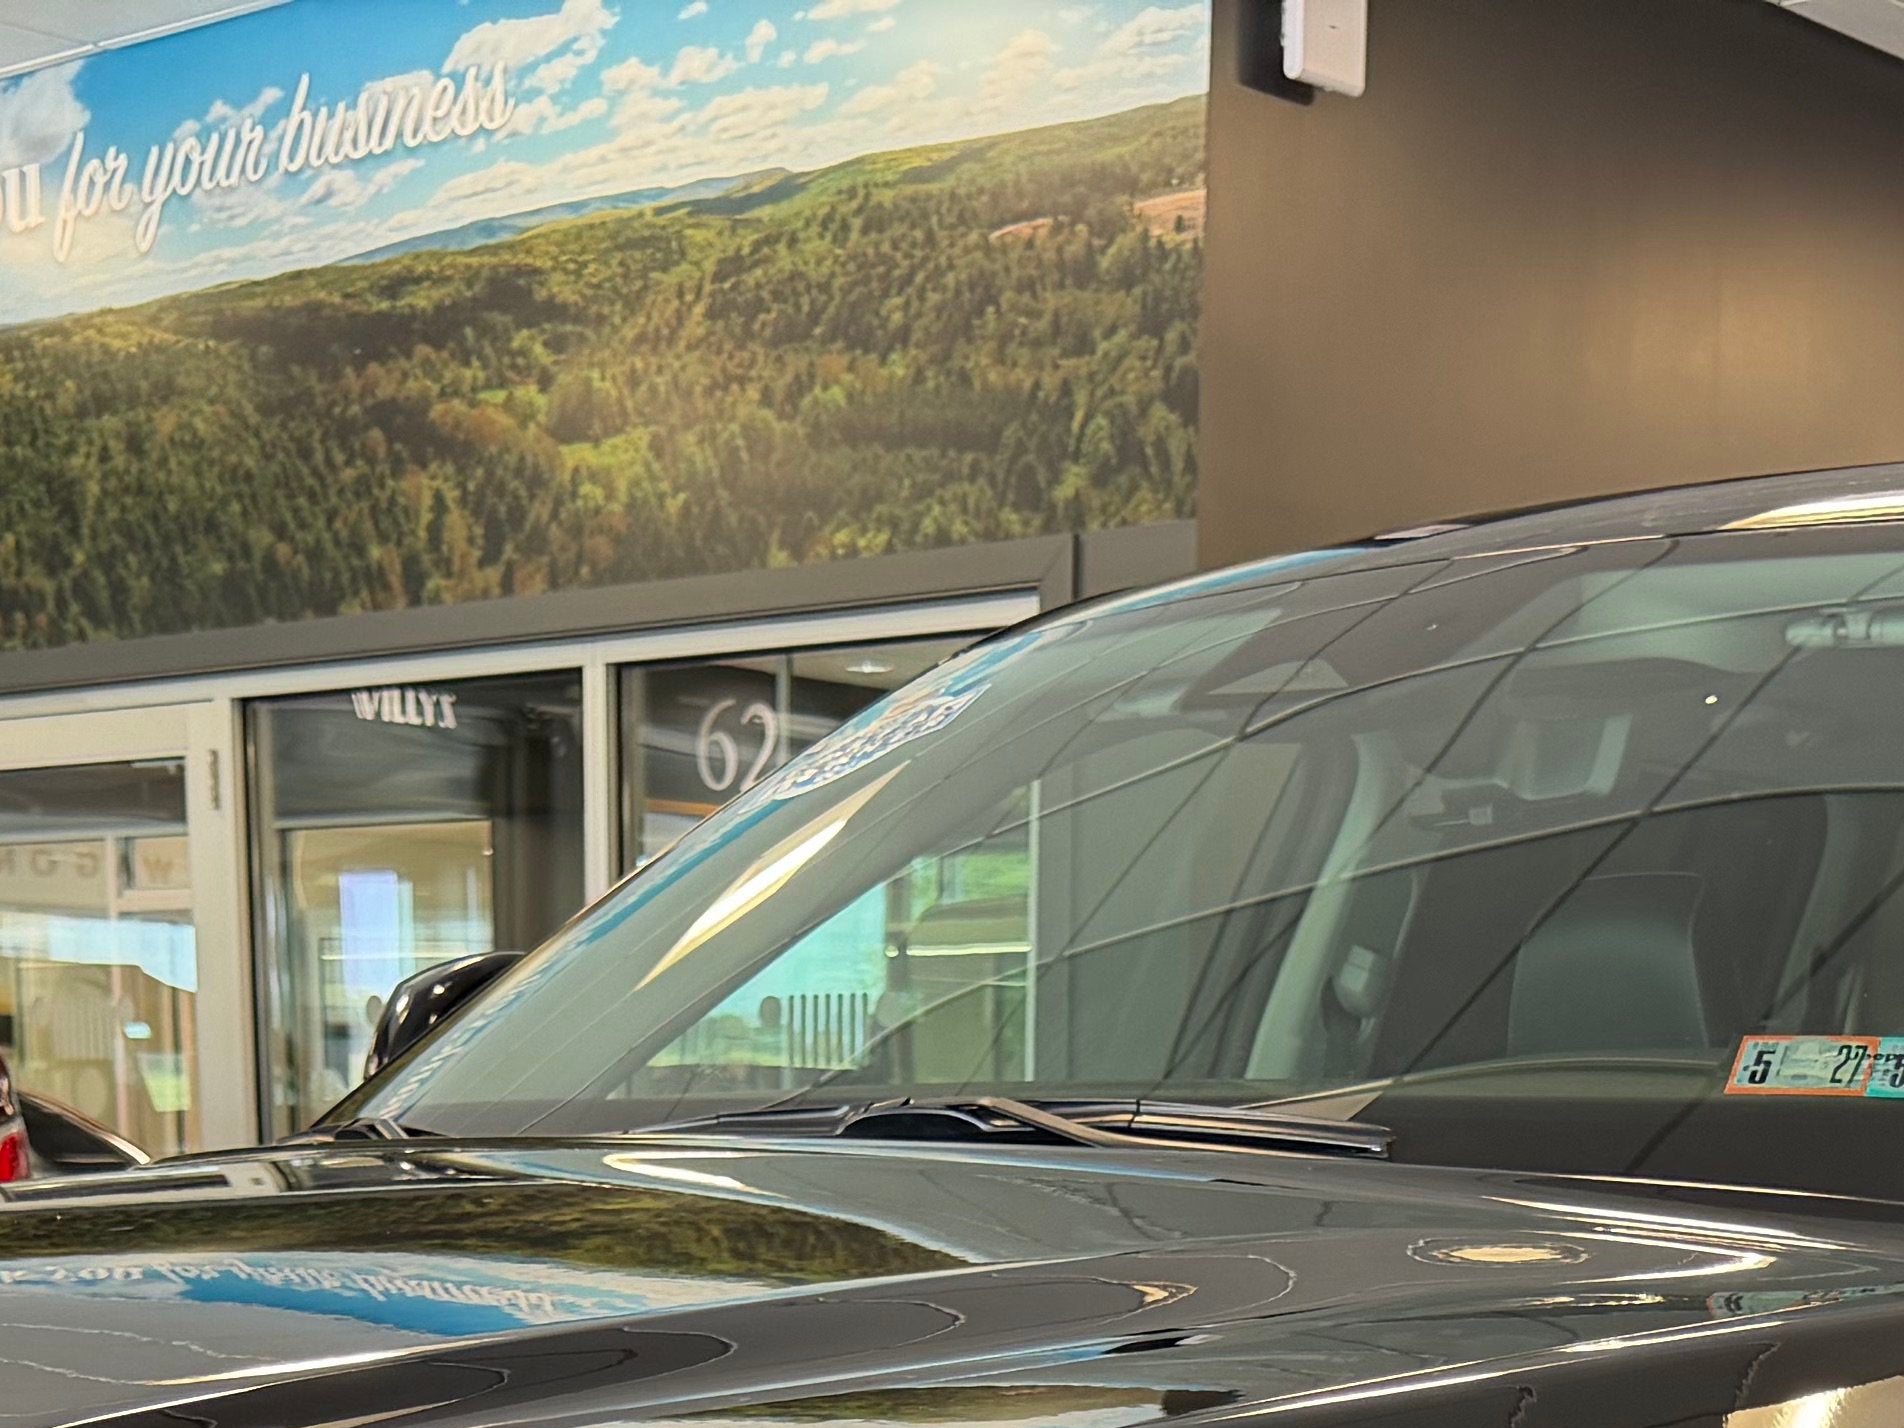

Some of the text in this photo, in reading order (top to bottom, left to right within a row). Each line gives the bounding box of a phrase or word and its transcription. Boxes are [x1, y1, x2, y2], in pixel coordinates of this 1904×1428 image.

[53, 132, 129, 262] for
[132, 123, 270, 255] your
[278, 59, 516, 172] business
[1747, 1043, 1868, 1085] 5 27
